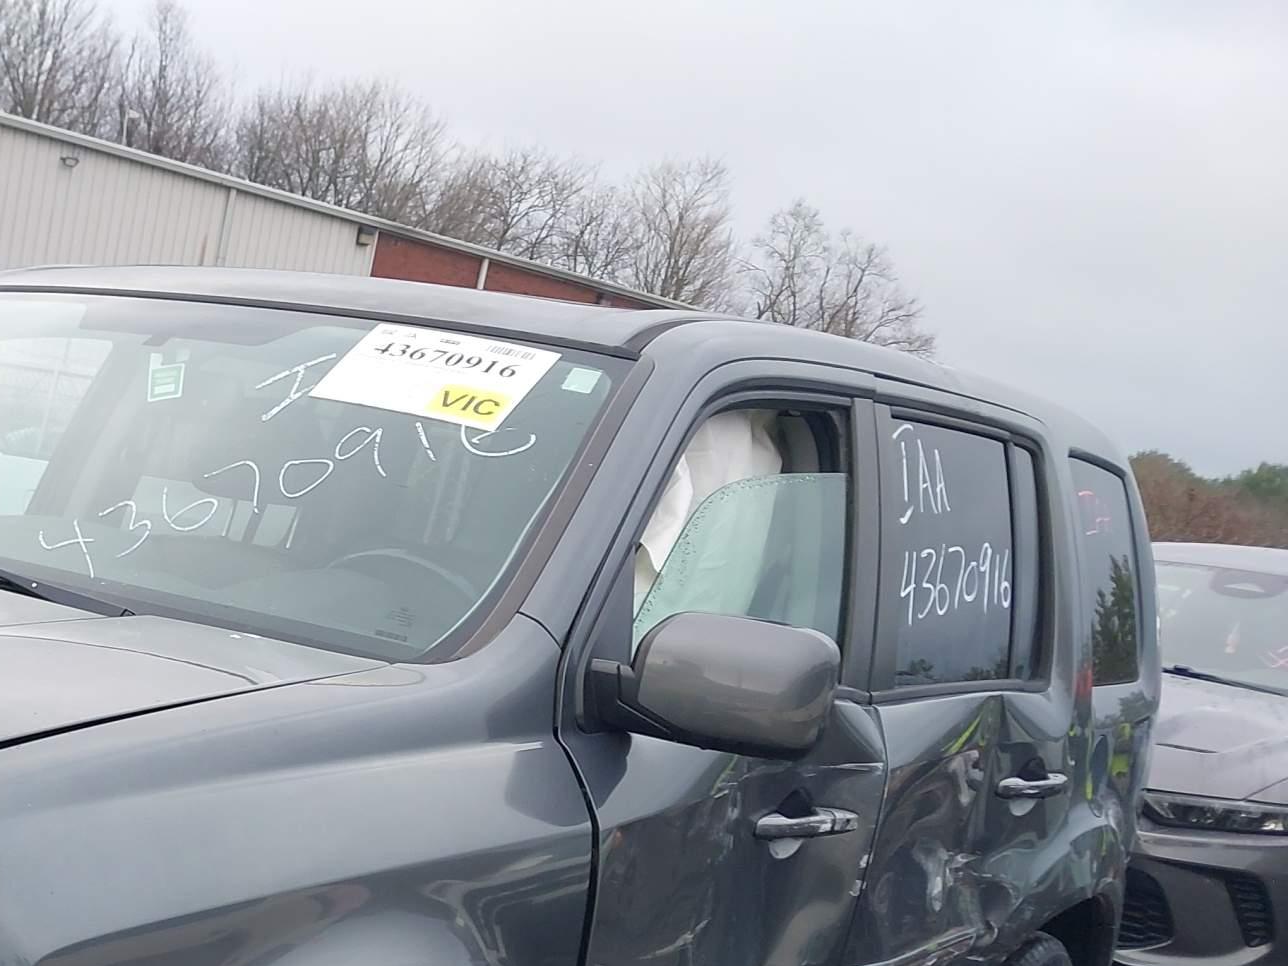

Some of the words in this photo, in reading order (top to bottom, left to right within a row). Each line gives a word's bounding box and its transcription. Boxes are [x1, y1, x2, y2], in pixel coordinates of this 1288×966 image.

[374, 341, 521, 379] 43670916
[441, 390, 501, 417] VIC
[892, 423, 952, 524] IAA
[899, 542, 1012, 627] 43670916
